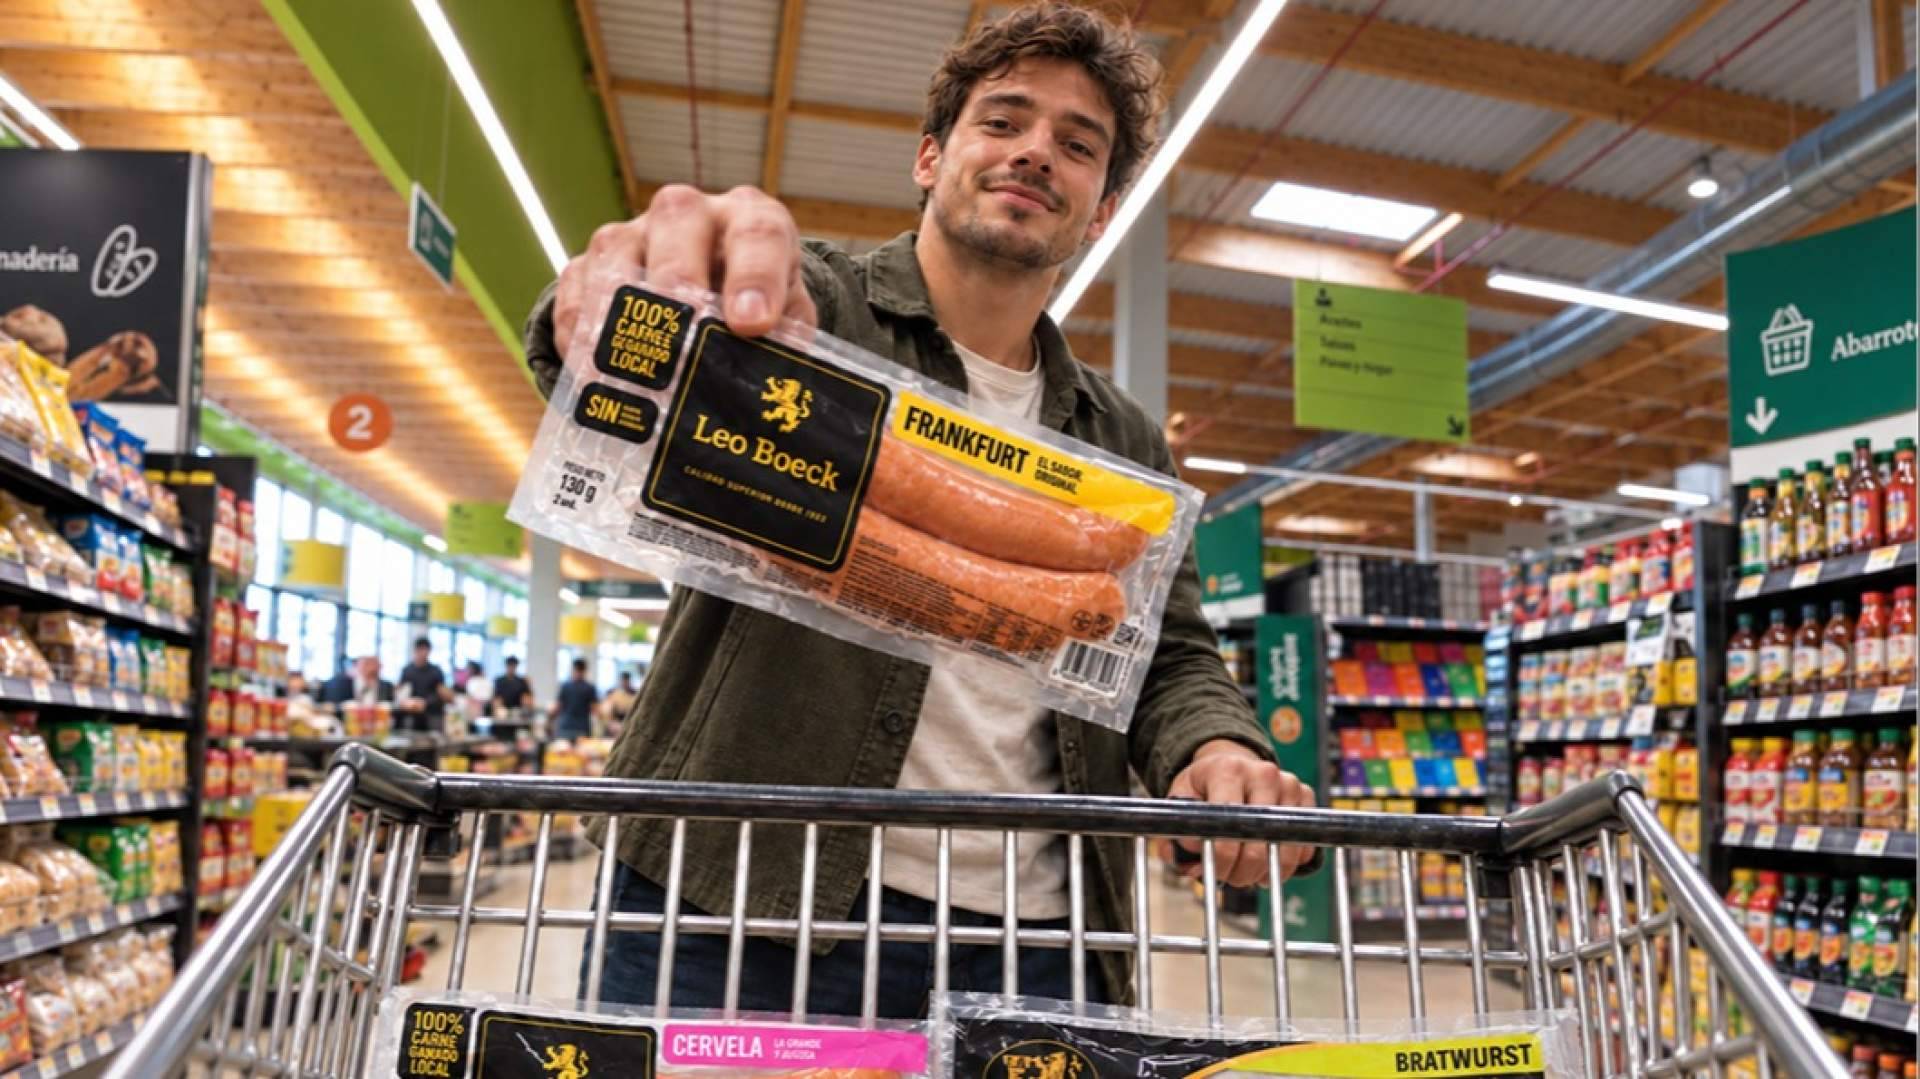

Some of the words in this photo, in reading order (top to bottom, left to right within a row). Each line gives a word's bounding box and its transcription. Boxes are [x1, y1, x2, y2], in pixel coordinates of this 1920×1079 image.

[624, 295, 681, 334] 100%
[609, 349, 657, 378] LOCAL
[347, 404, 374, 440] 2
[585, 394, 621, 424] SIN
[692, 414, 748, 455] Leo
[751, 436, 841, 492] Boeck
[903, 405, 1030, 474] FRANKFURT
[560, 474, 587, 496] 130
[584, 485, 598, 504] g
[683, 464, 726, 486] CALIDAD
[552, 493, 561, 505] 2
[413, 1010, 465, 1035] 100%
[672, 1033, 763, 1059] CERVELA
[1396, 1043, 1533, 1073] BRATWURST
[410, 1058, 450, 1078] LOCAL
